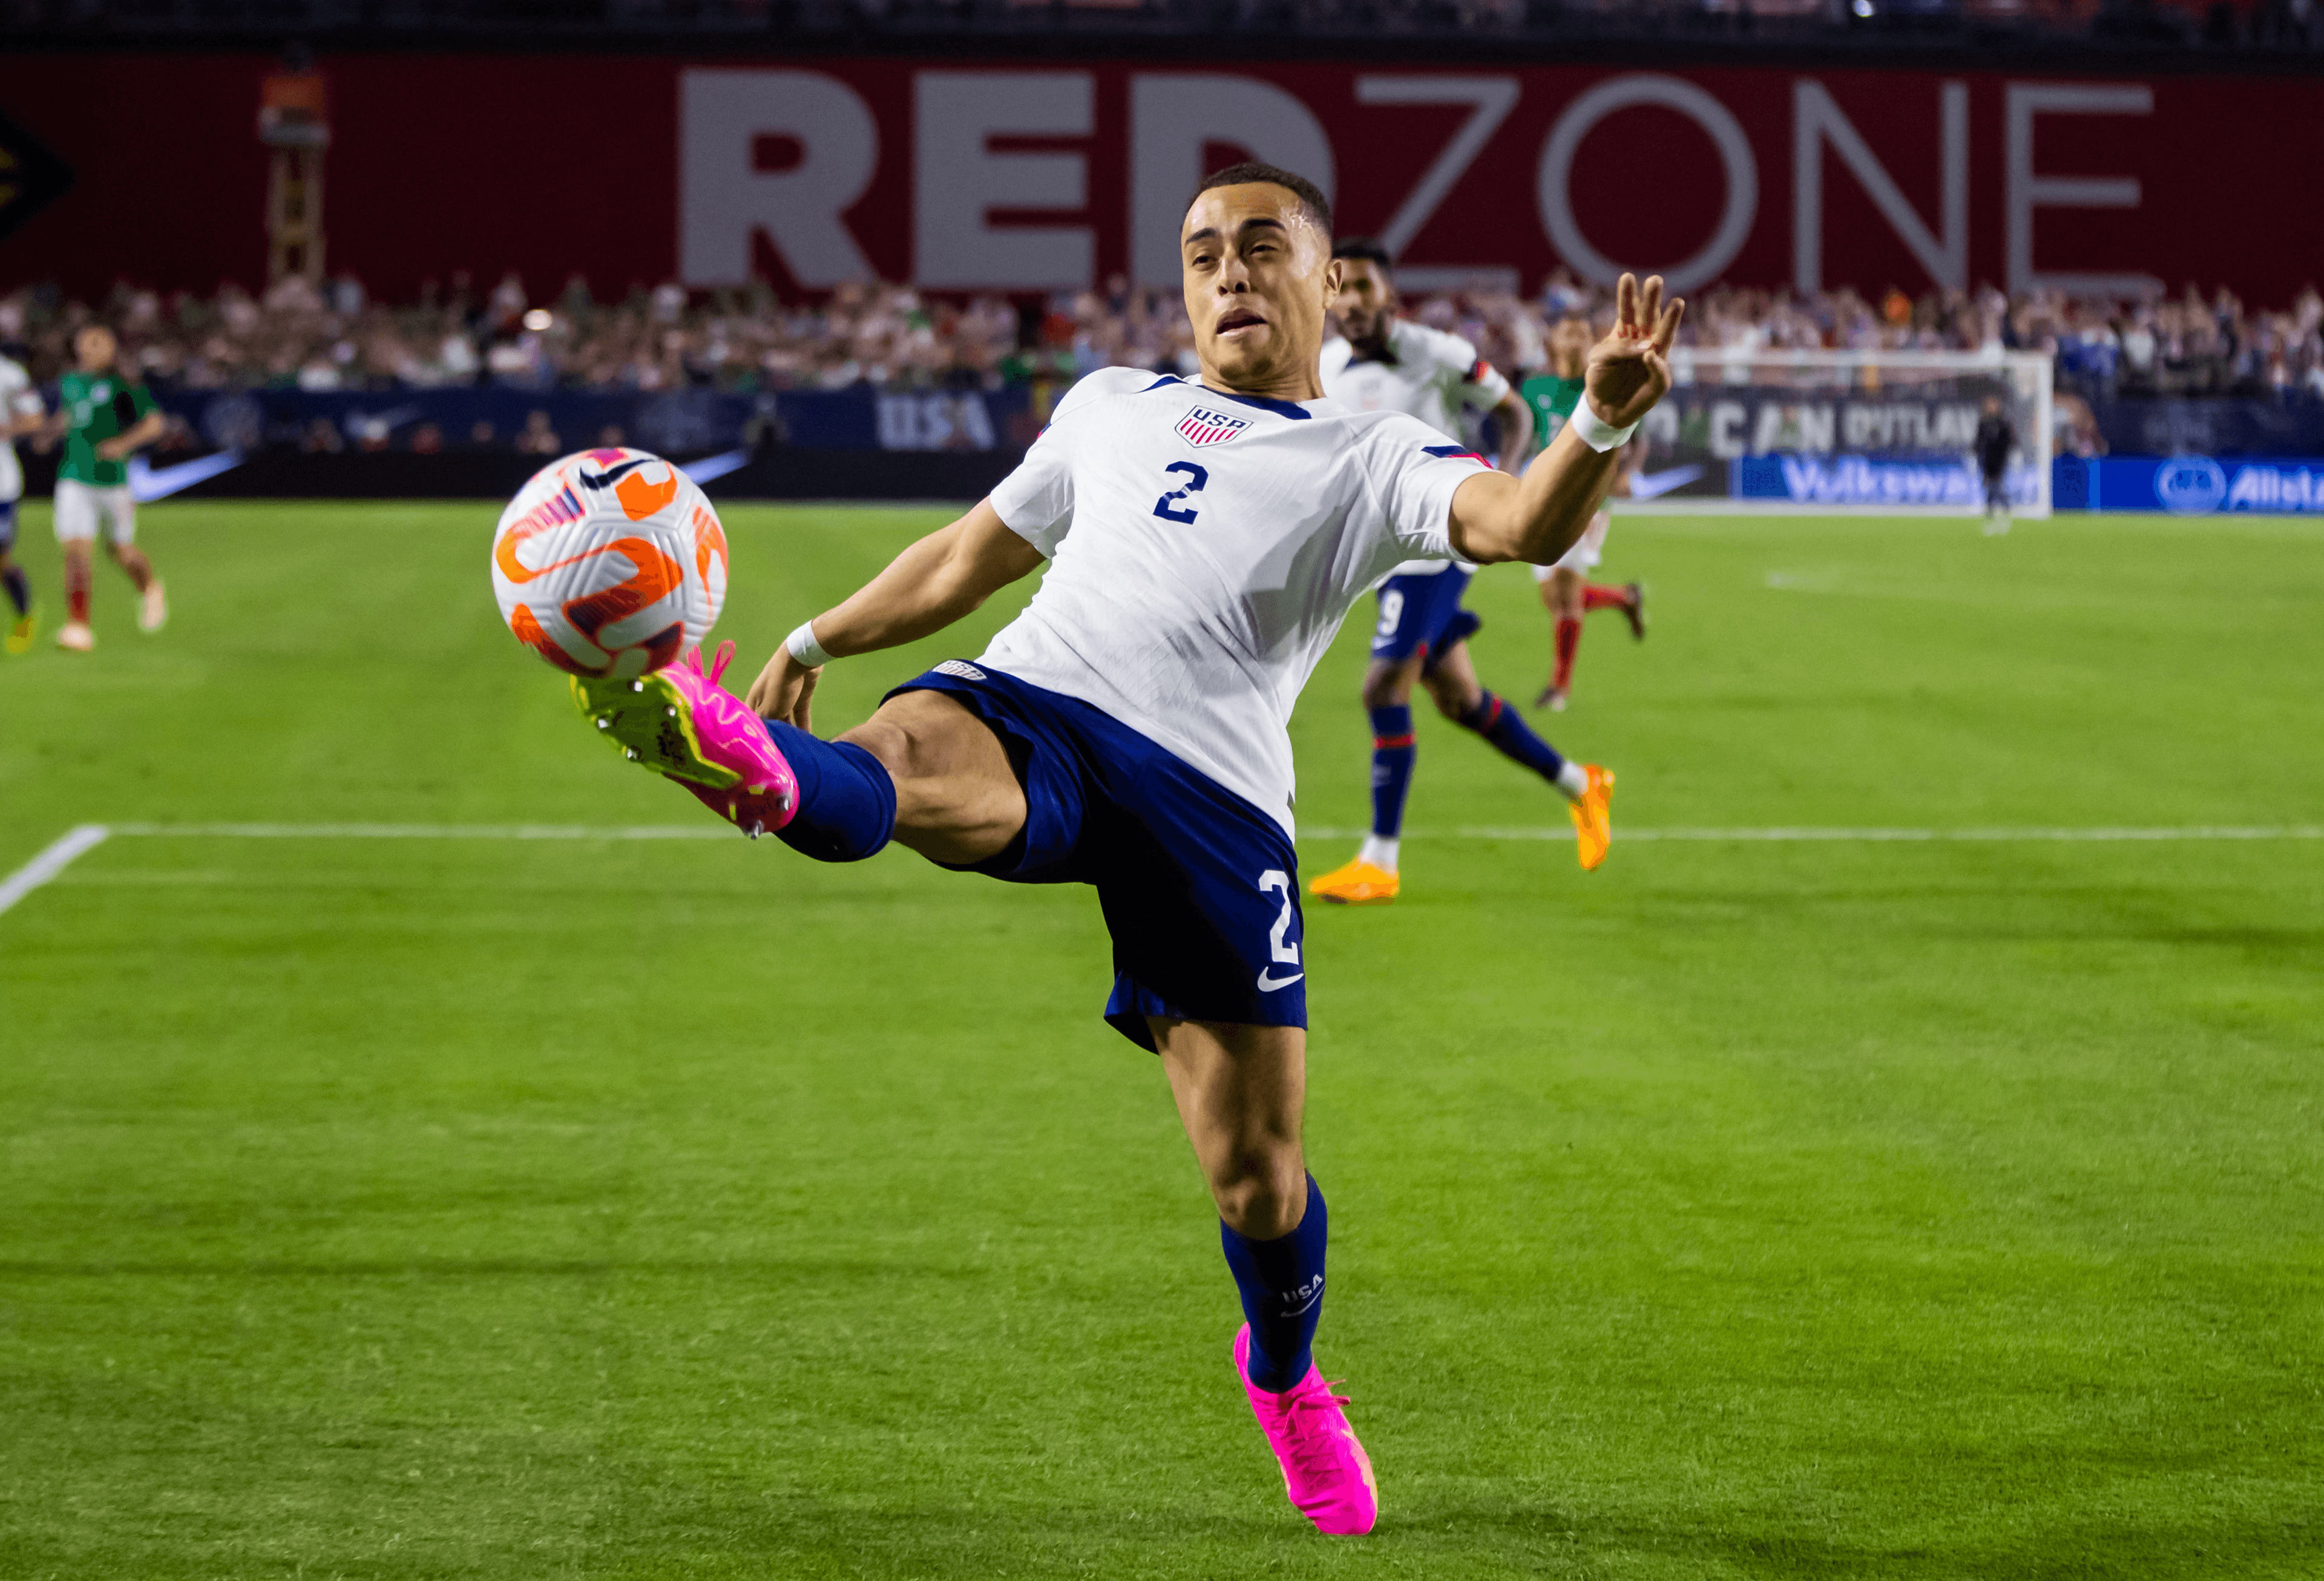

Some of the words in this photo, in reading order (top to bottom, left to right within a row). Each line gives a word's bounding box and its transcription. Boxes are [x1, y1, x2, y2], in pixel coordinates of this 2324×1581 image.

[1193, 409, 1246, 428] USA
[1153, 460, 1209, 525] 2
[1379, 590, 1404, 635] 9
[1258, 869, 1299, 965] 2
[1282, 1274, 1323, 1302] USA
